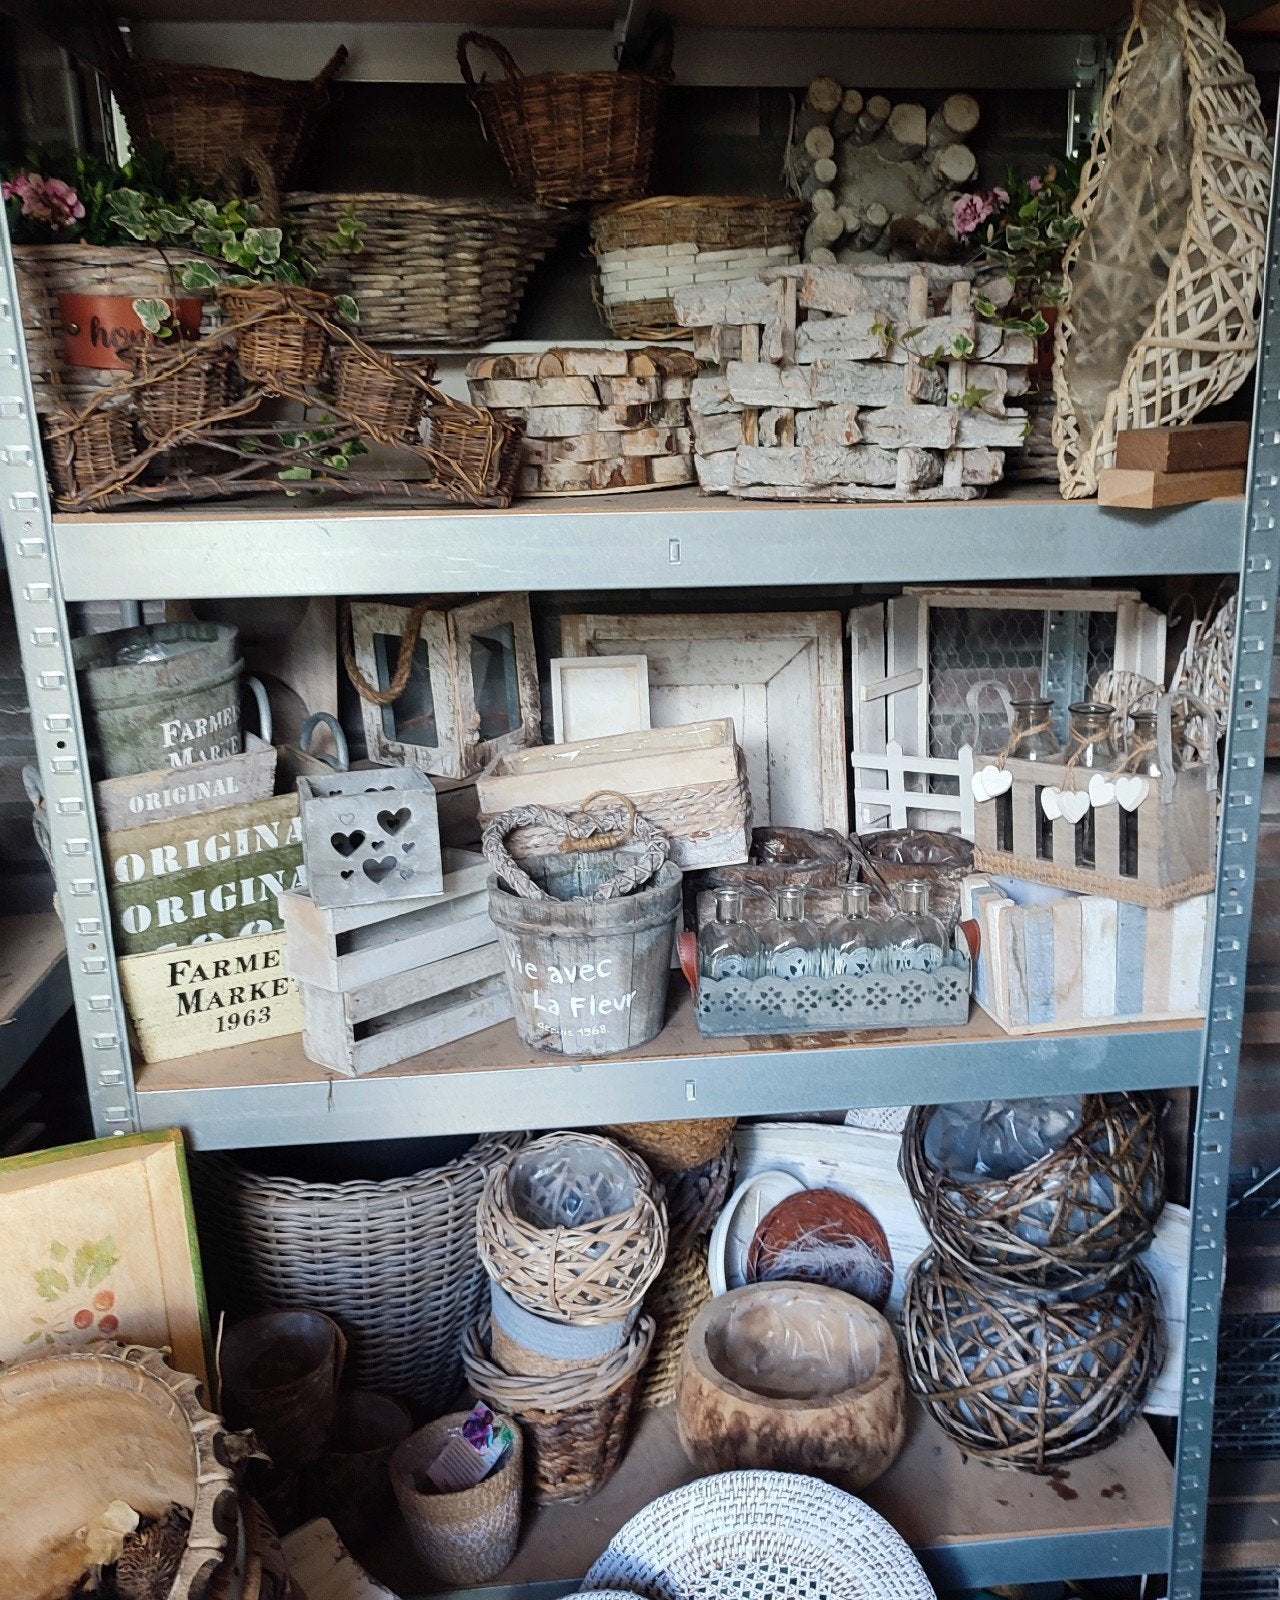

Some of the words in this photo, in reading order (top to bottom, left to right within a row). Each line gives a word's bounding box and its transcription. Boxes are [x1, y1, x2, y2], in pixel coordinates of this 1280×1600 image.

[128, 776, 239, 814] ORIGINAL
[114, 816, 303, 883] ORIGINA
[122, 865, 307, 934] ORIGINA
[166, 949, 281, 988] FARME
[547, 958, 613, 985] avec
[175, 976, 300, 1017] MARKE
[533, 989, 561, 1016] La
[570, 990, 637, 1018] Fleur
[215, 1006, 271, 1033] 1963
